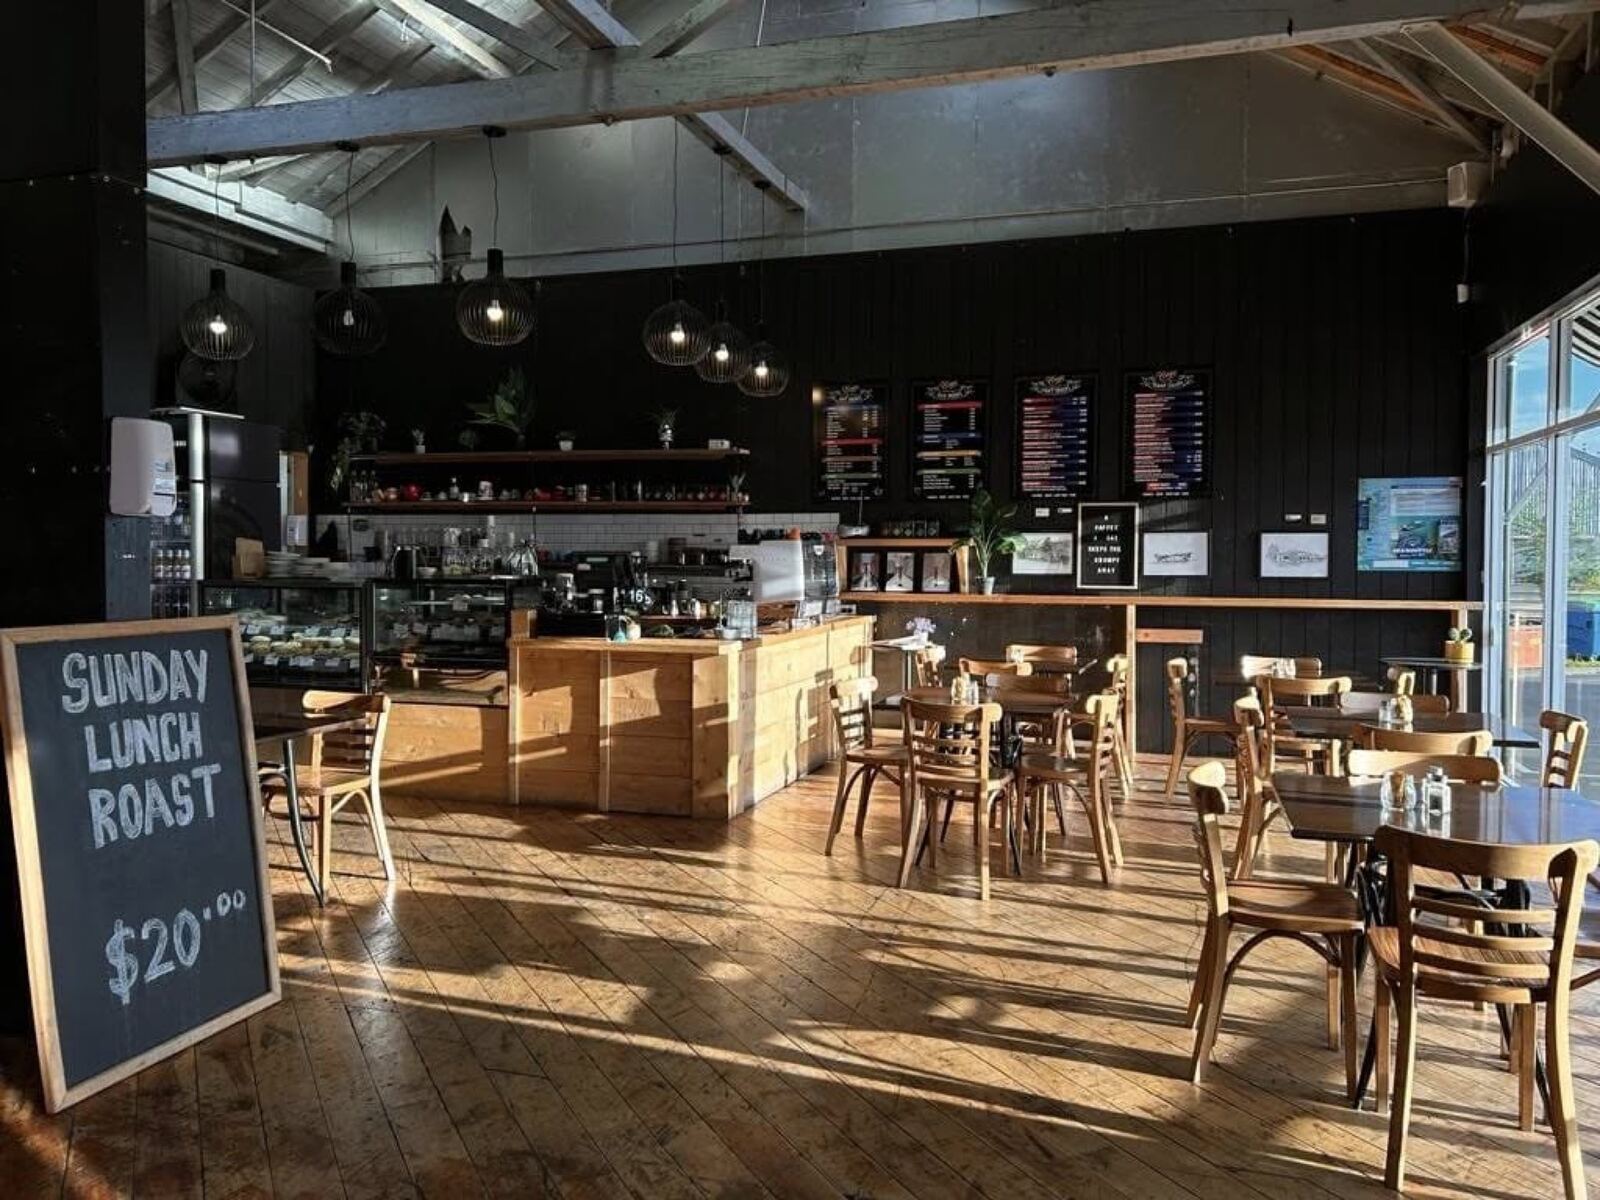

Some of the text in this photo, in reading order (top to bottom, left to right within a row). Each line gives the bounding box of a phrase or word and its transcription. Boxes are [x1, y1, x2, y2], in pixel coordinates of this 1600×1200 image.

[62, 649, 208, 713] SUNDAY
[84, 712, 203, 773] LUNCH
[88, 763, 222, 849] ROAST
